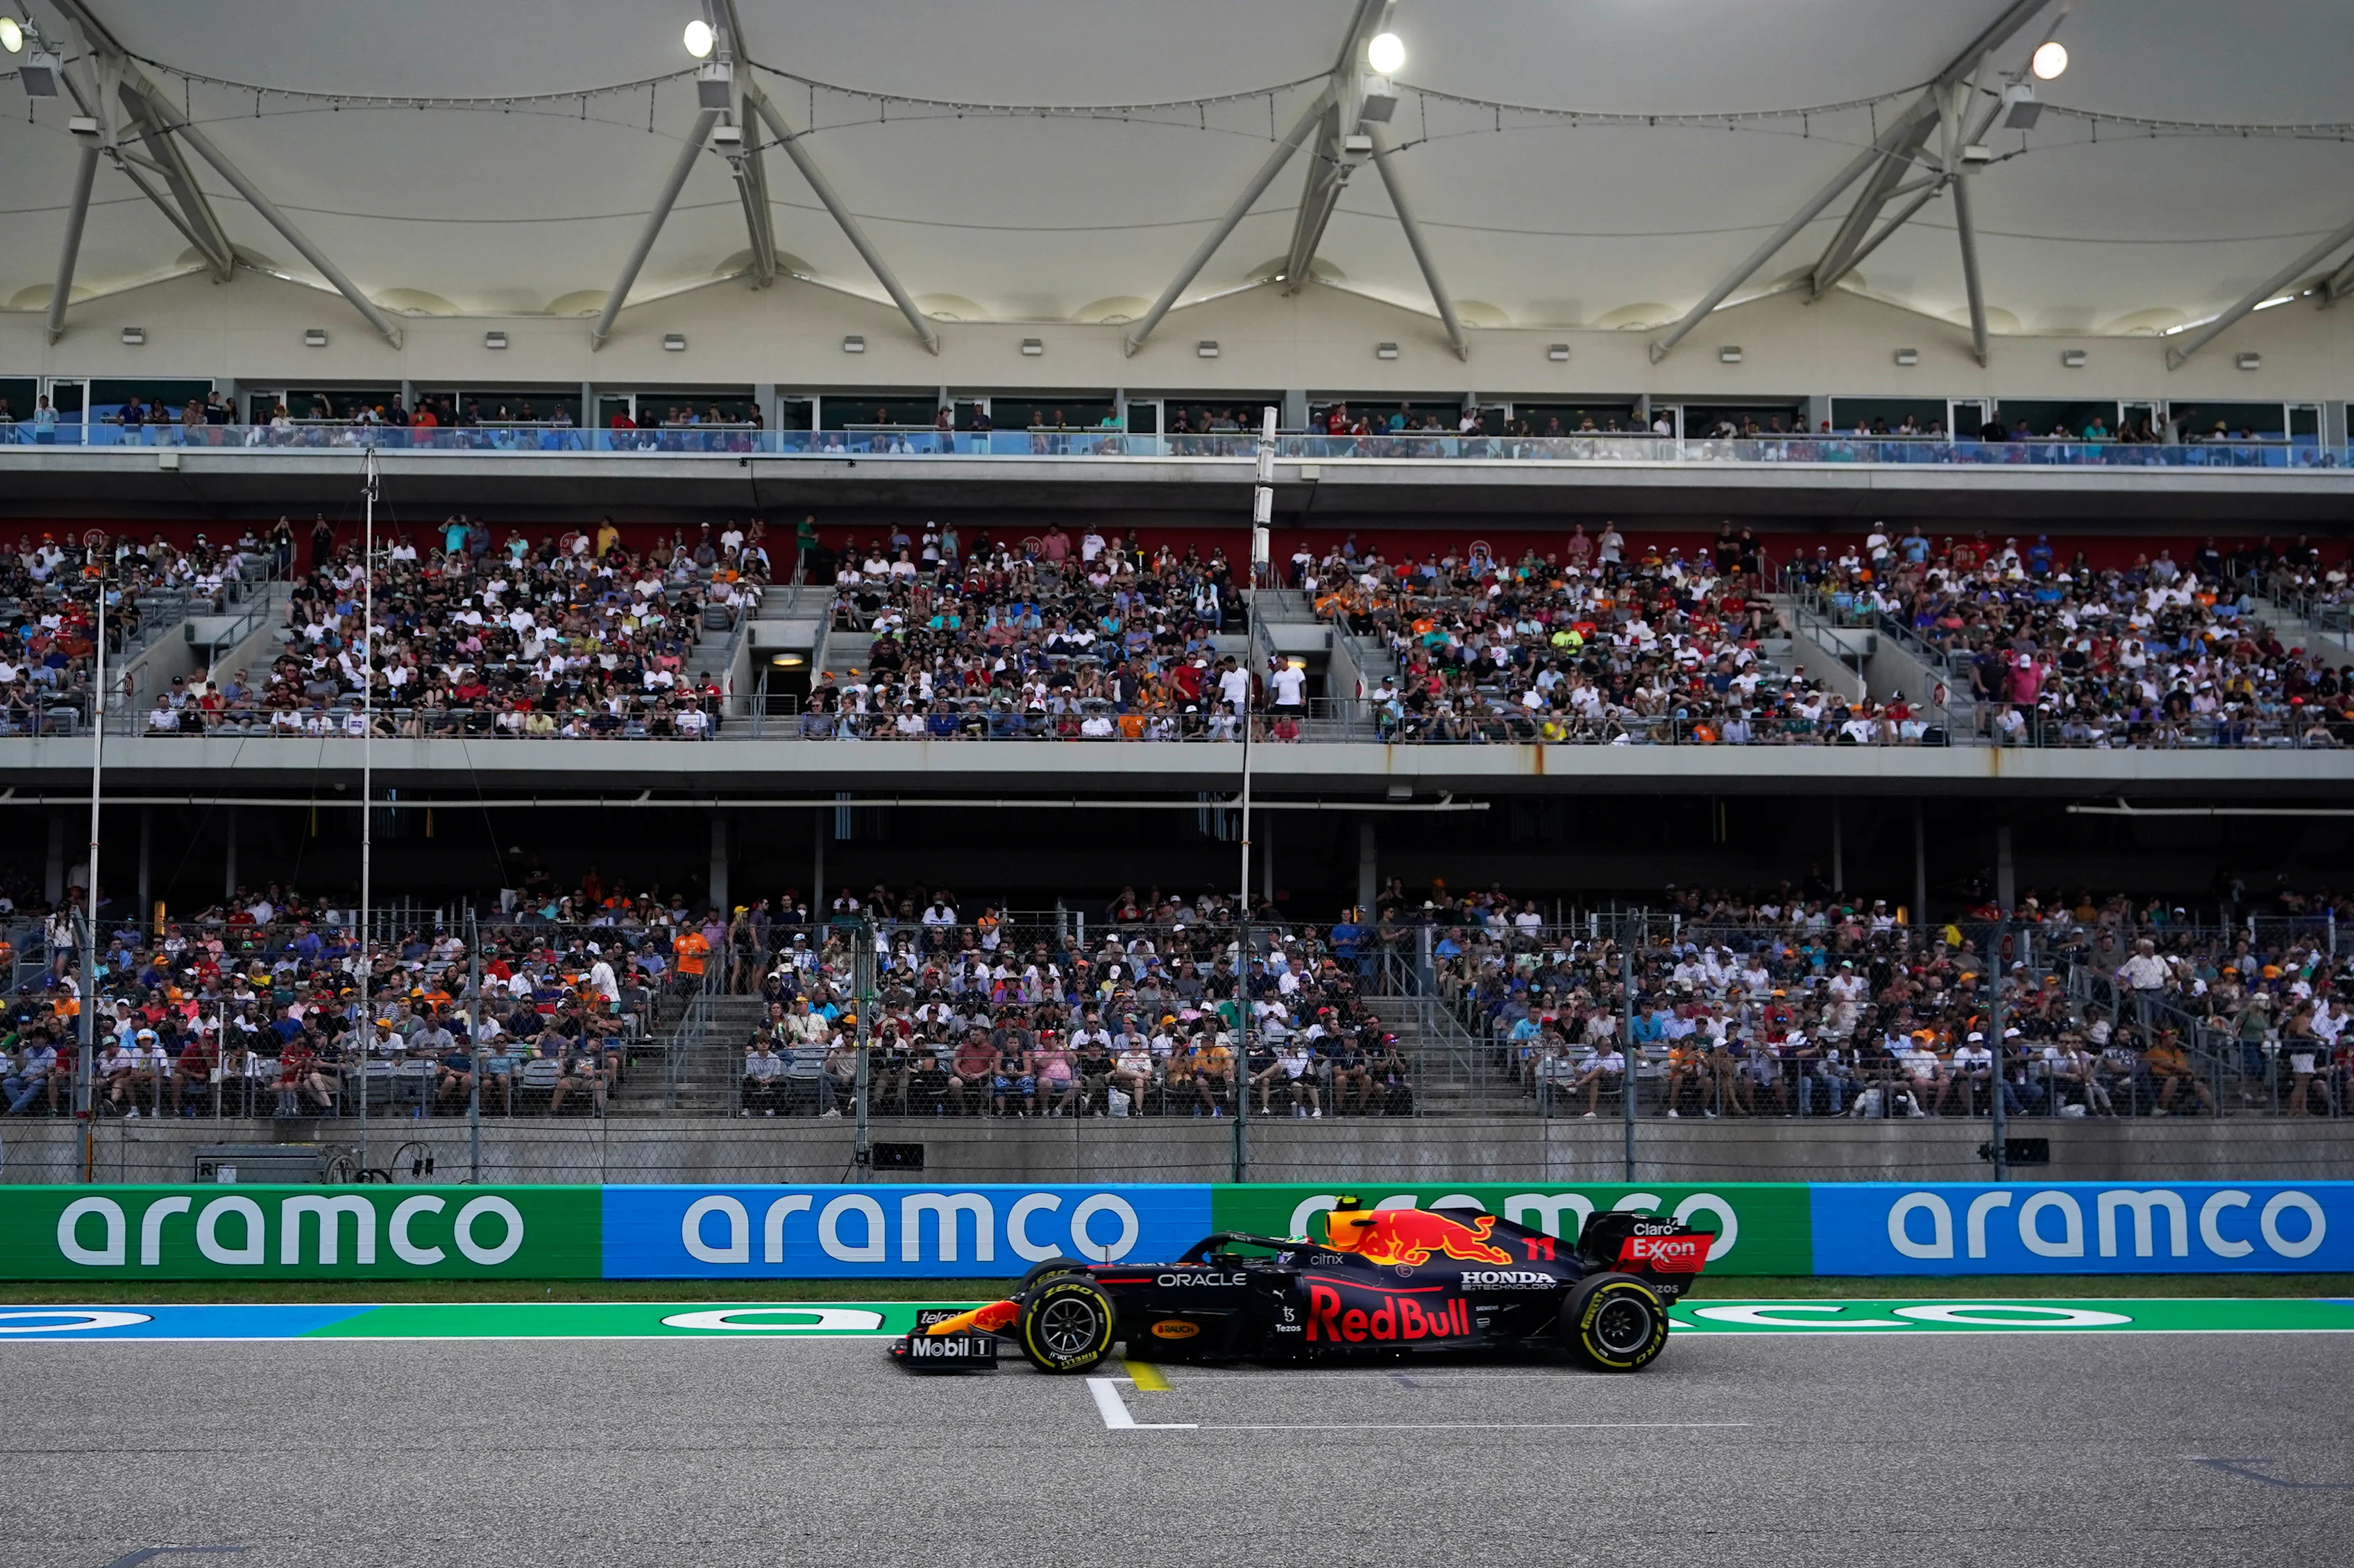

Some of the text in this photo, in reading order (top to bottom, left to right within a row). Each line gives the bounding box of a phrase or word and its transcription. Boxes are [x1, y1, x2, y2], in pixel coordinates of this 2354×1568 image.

[56, 1194, 525, 1266] aramco
[681, 1192, 1140, 1264] aramco
[1634, 1223, 1674, 1236] Claro
[1888, 1189, 2327, 1259] aramco
[1521, 1237, 1555, 1261] 11
[1633, 1238, 1695, 1262] Exxon
[1157, 1272, 1247, 1287] ORACLE
[1460, 1271, 1557, 1284] HONDA
[1044, 1284, 1094, 1299] ZERO
[920, 1311, 962, 1324] telc
[1165, 1325, 1194, 1333] RAUCH
[1276, 1324, 1302, 1332] Tezos
[912, 1338, 985, 1357] Mobil 1
[1636, 1322, 1664, 1365] ZERO
[1061, 1350, 1099, 1370] PIRELLI
